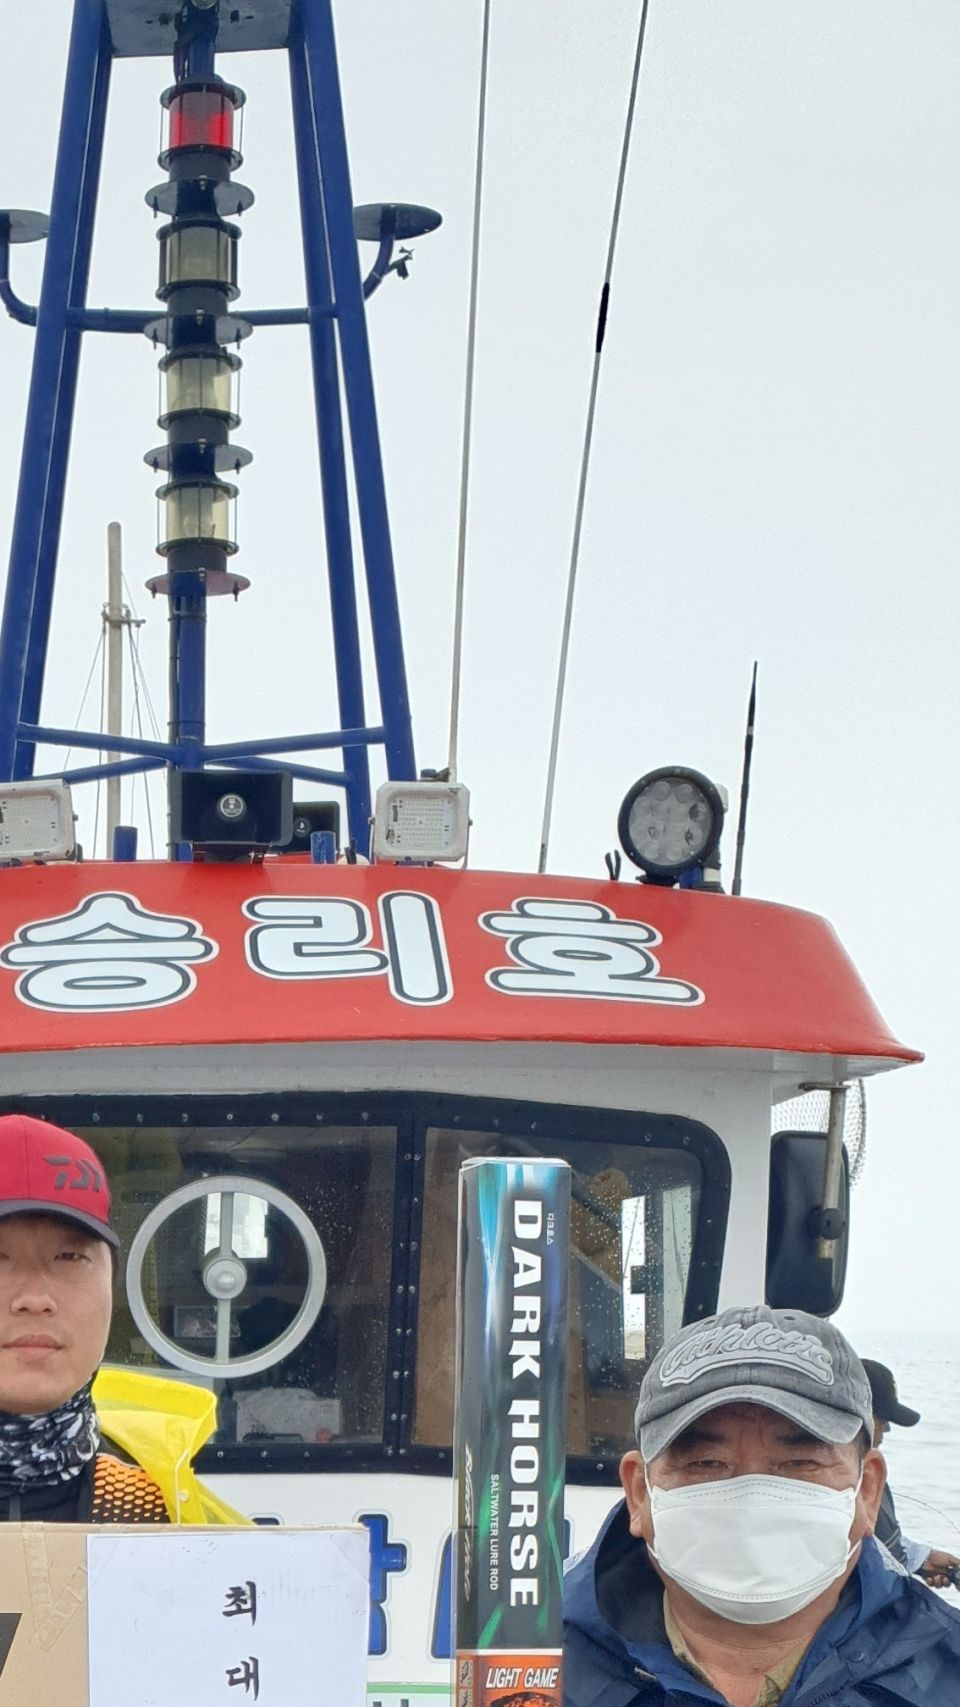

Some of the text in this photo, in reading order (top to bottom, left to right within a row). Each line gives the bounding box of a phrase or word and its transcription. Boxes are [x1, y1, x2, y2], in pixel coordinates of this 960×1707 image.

[507, 1200, 543, 1607] DARK HORSE
[489, 1474, 500, 1591] SALTWATER LURE ROD
[485, 1667, 560, 1689] LIGHT GAME
